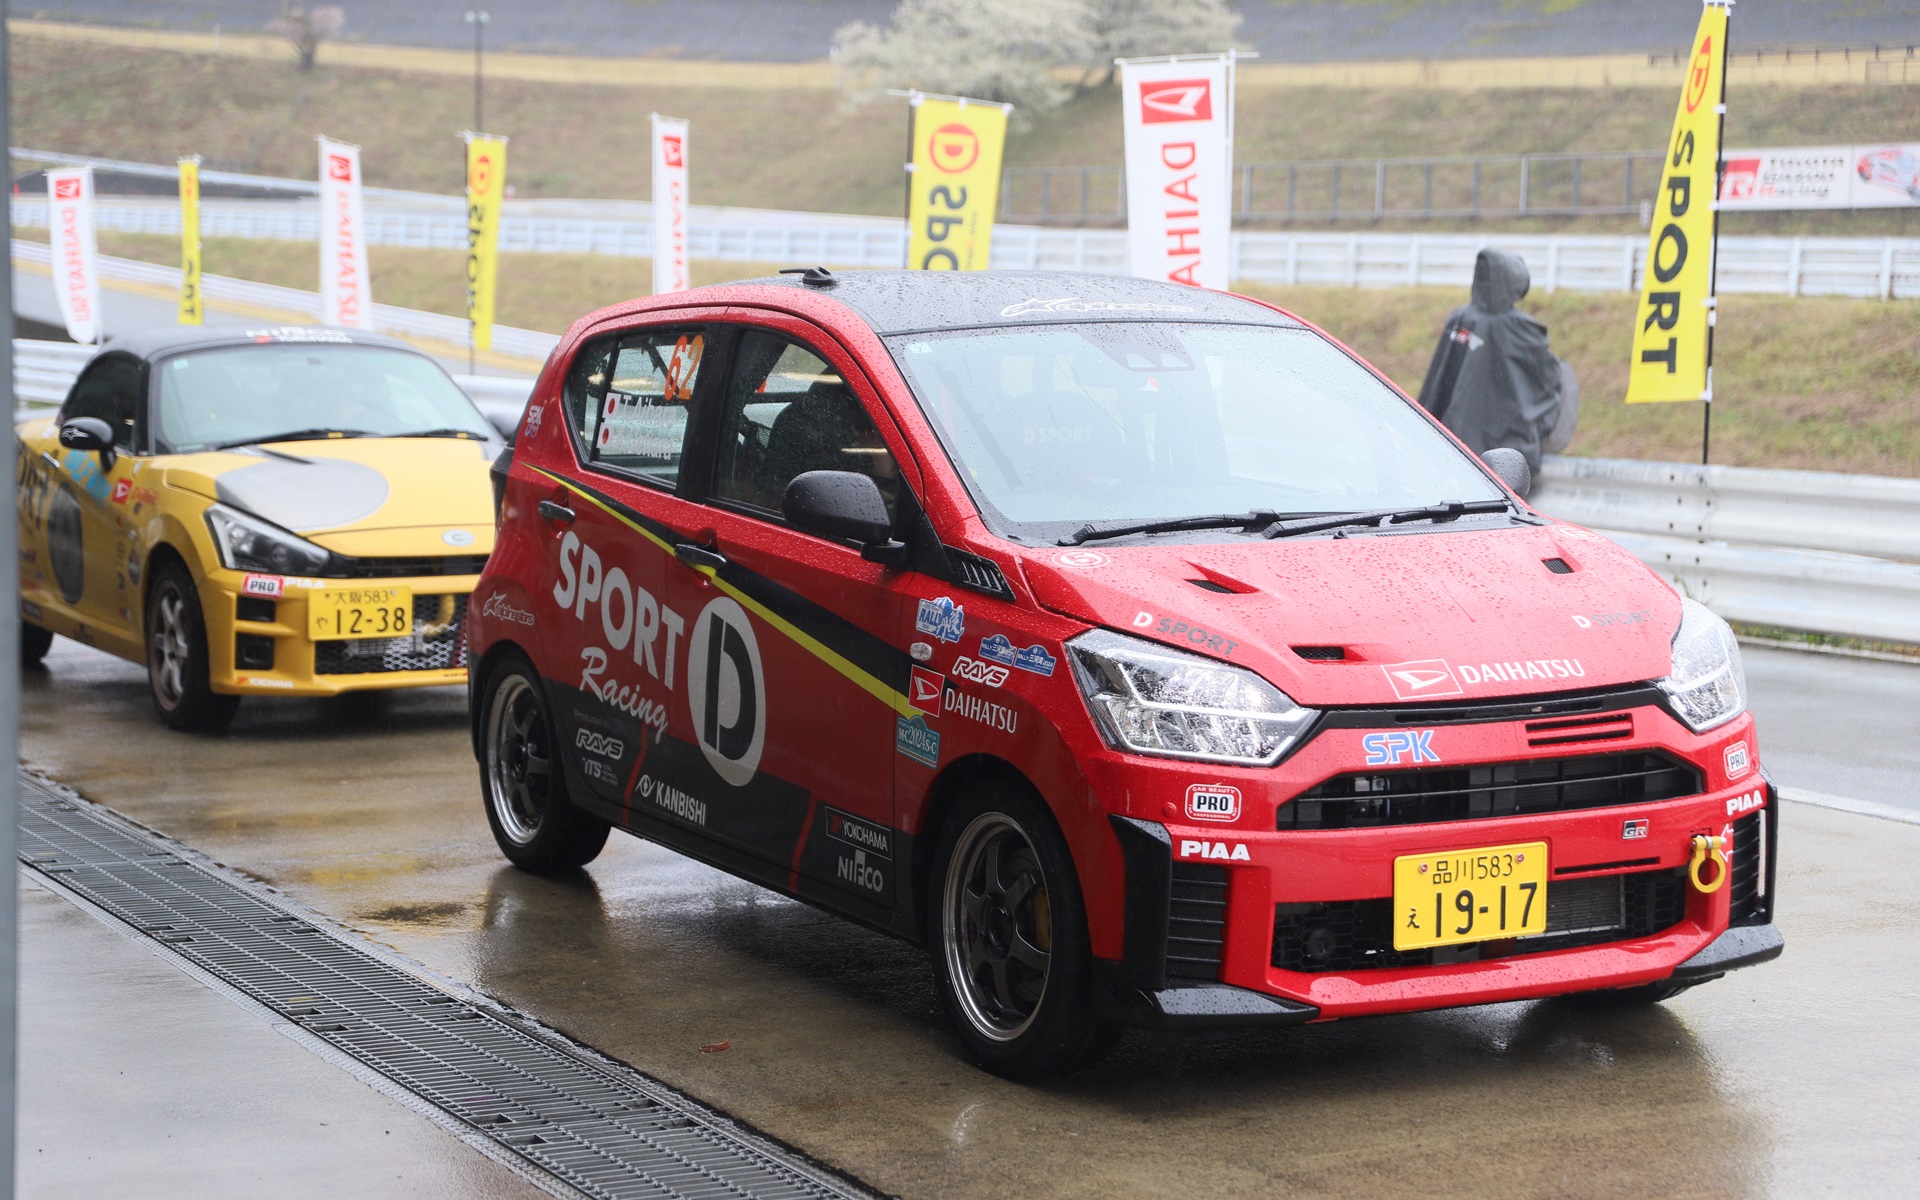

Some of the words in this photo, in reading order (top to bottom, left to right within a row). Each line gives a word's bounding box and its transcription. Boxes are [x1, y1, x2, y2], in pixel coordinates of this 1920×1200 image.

[1641, 129, 1694, 374] SPORT
[664, 335, 704, 400] 62
[1039, 426, 1094, 443] SPORT
[250, 581, 275, 592] PRO
[336, 607, 405, 634] 12-38
[553, 530, 685, 691] SPORT
[1571, 615, 1591, 628] D
[1592, 609, 1656, 627] SPORT
[1132, 611, 1153, 627] D
[1155, 617, 1239, 656] SPORT
[952, 656, 1009, 687] RAYS
[1458, 659, 1585, 684] DAIHATSU
[579, 647, 668, 744] Racing
[945, 687, 1018, 734] DAIHATSU
[576, 727, 624, 760] RAYS
[1362, 730, 1442, 766] SPK
[1730, 751, 1745, 769] PRO
[656, 781, 707, 827] KANBISHI
[1197, 795, 1229, 811] PRO
[1726, 789, 1763, 816] PIAA
[842, 819, 888, 852] YOKOHAMA
[1623, 825, 1648, 838] GR
[1180, 840, 1251, 861] PIAA
[837, 849, 883, 893] NIFCO
[1407, 908, 1420, 928] え
[1435, 881, 1538, 938] 19-17
